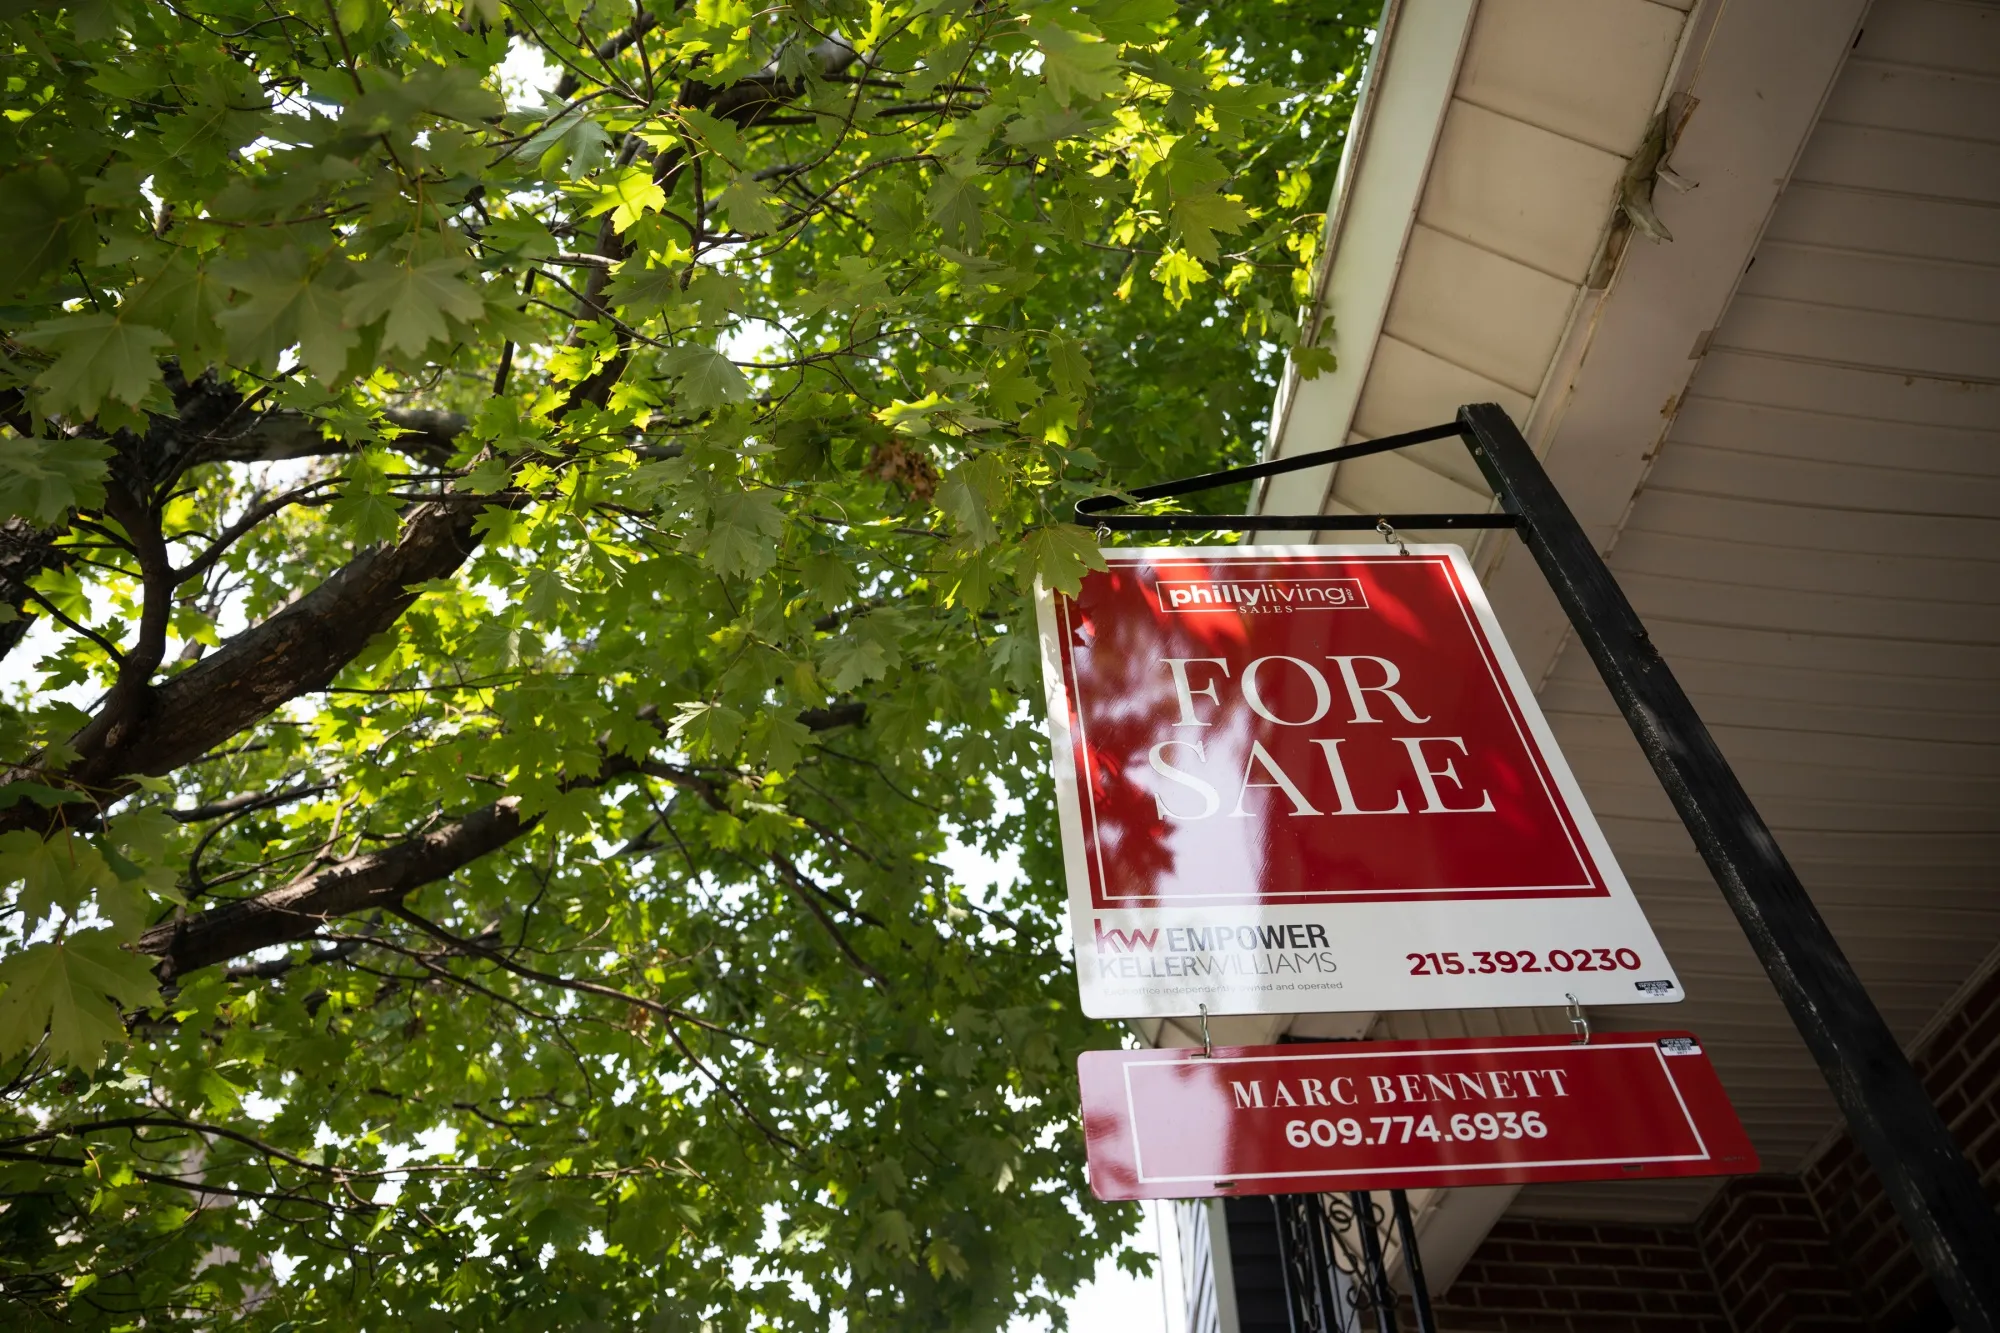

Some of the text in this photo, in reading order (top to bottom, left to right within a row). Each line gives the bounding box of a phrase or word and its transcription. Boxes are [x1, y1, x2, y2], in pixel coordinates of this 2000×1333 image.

[1238, 604, 1294, 614] SALES
[1159, 655, 1432, 727] FOR
[1147, 736, 1497, 821] SALE
[1094, 918, 1330, 953] kw EMPOWER
[1405, 947, 1642, 976] 215.392.0230
[1275, 982, 1295, 991] and
[1297, 981, 1344, 993] operated
[1230, 1067, 1570, 1110] MARC BENNETT
[1284, 1111, 1549, 1149] 609.774.6936
